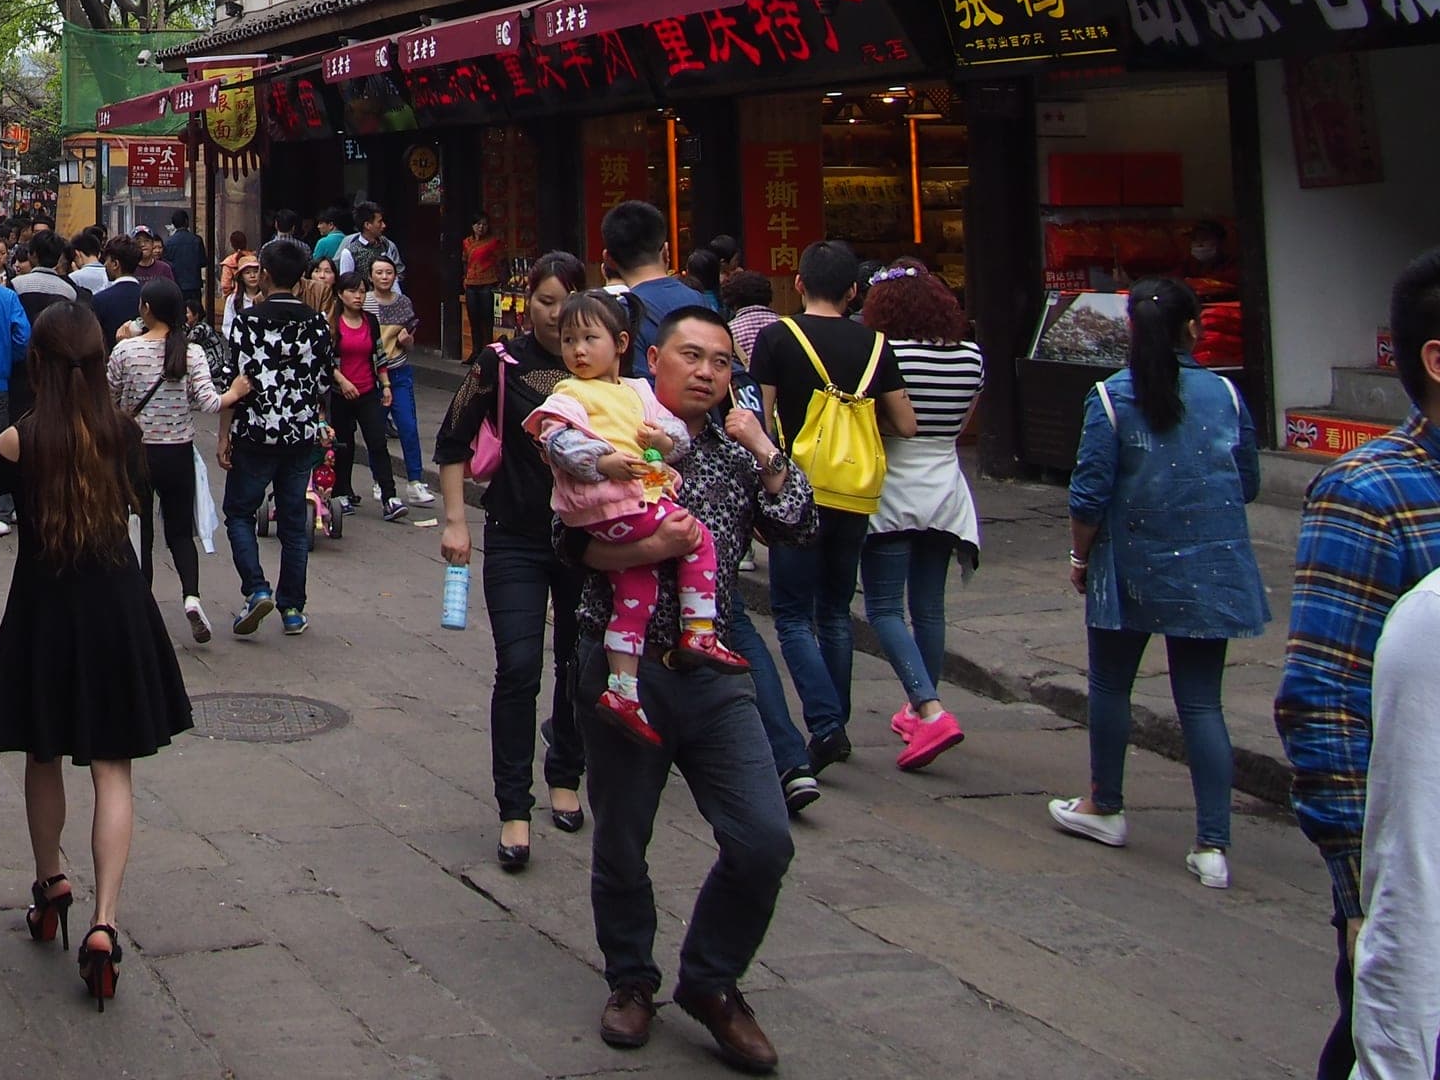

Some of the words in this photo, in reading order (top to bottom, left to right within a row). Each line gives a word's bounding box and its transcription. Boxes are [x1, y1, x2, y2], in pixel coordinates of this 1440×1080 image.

[555, 3, 588, 35] 王老吉
[413, 35, 437, 62] 王老吉
[331, 54, 351, 76] 王老吉
[764, 149, 800, 271] 手撕牛肉
[1325, 426, 1376, 450] 看川剧
